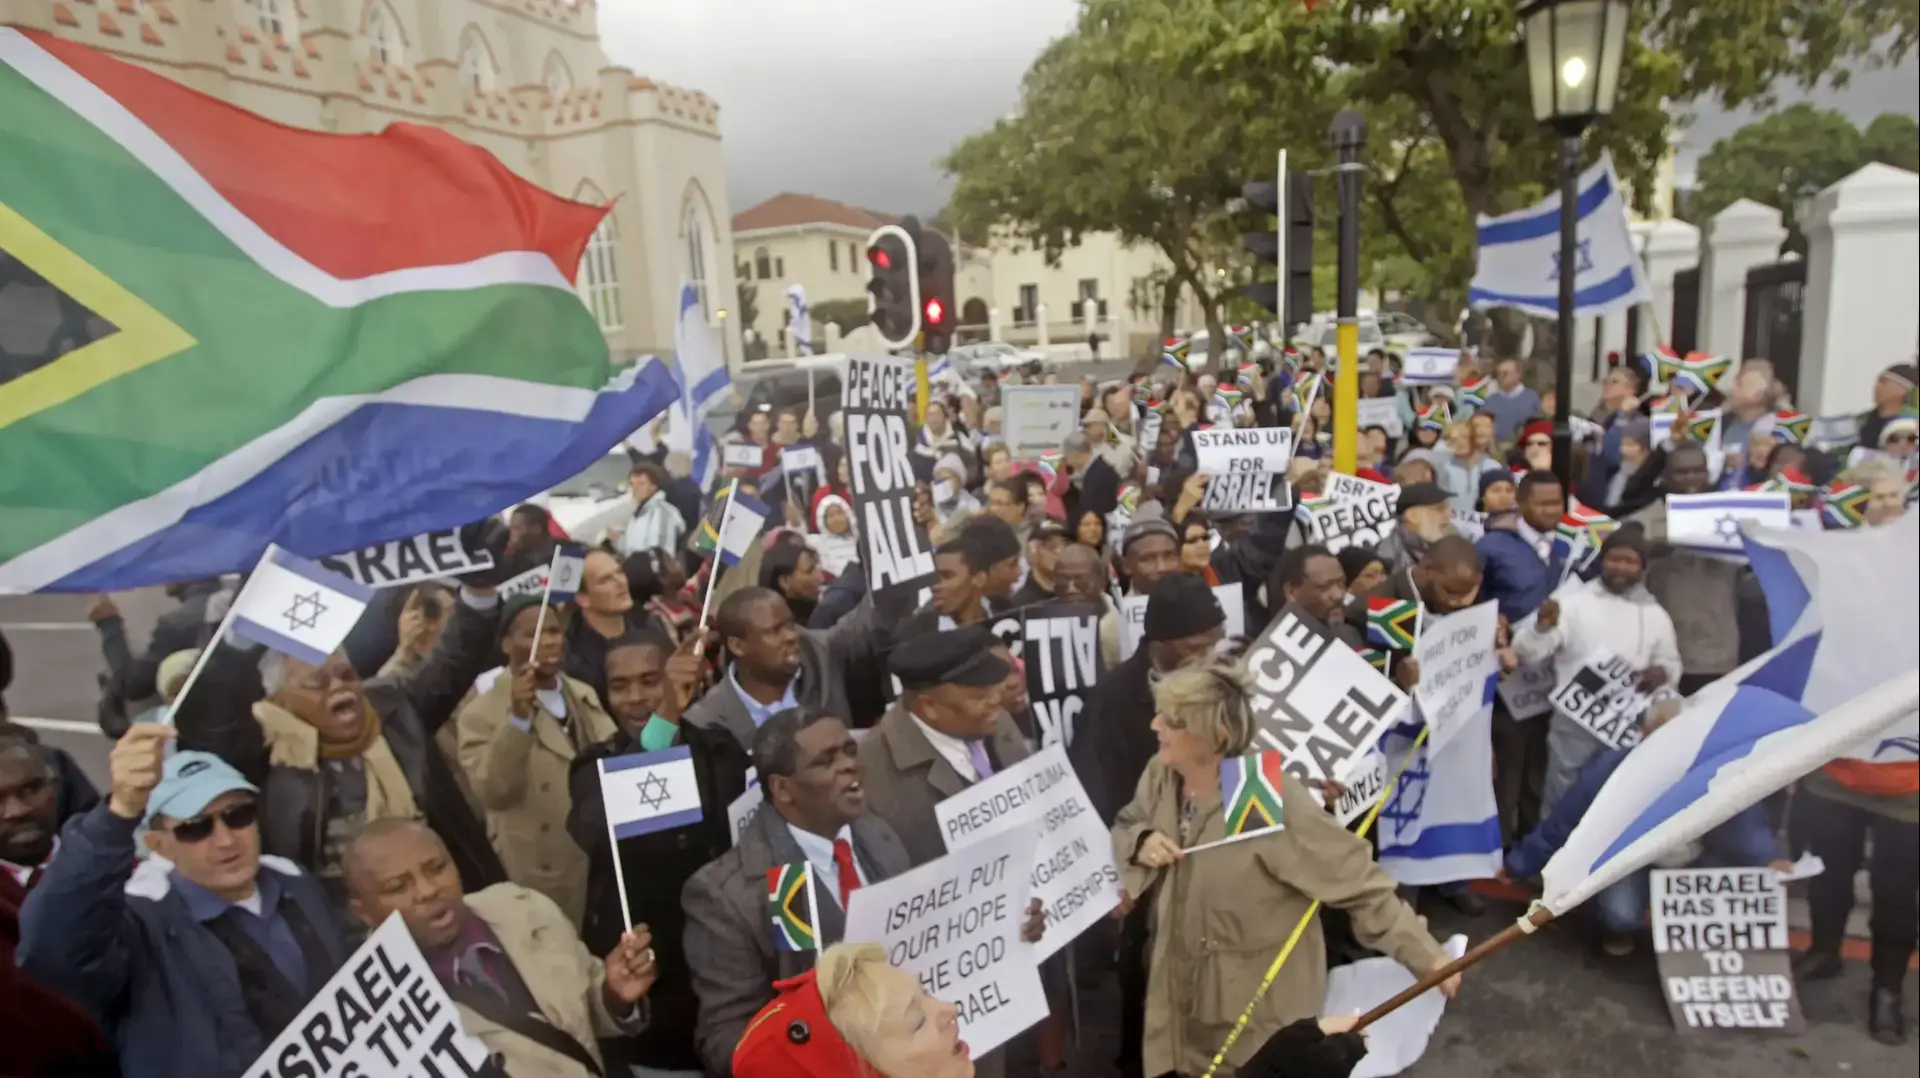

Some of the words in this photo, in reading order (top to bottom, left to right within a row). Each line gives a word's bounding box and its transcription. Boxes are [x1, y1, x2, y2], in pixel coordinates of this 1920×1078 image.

[850, 359, 908, 410] PEACE
[848, 413, 915, 495] FOR
[1198, 431, 1260, 447] STAND
[1266, 429, 1290, 445] UP
[1230, 457, 1264, 473] FOR
[1201, 473, 1277, 509] ISRAEL
[1318, 491, 1397, 540] PEACE
[865, 496, 935, 591] ALL
[1025, 615, 1098, 694] ALL
[946, 779, 1037, 842] PRESIDENT
[1035, 762, 1069, 794] ZUMA
[1339, 766, 1384, 815] STAND
[1043, 796, 1086, 832] ISRAEL
[1074, 836, 1090, 865] IN
[885, 876, 962, 934] ISRAEL
[969, 854, 1010, 894] PUT
[1666, 873, 1774, 894] ISRAEL
[946, 893, 1007, 943] HOPE
[1662, 898, 1715, 917] HAS
[1723, 895, 1779, 915] THE
[957, 935, 1006, 978] GOD
[1666, 921, 1778, 950] RIGHT
[1702, 950, 1744, 974] TO
[1667, 973, 1791, 1003] DEFEND
[256, 944, 412, 1078] SRAEL
[365, 976, 442, 1068] THE
[1682, 1001, 1790, 1028] ITSELF
